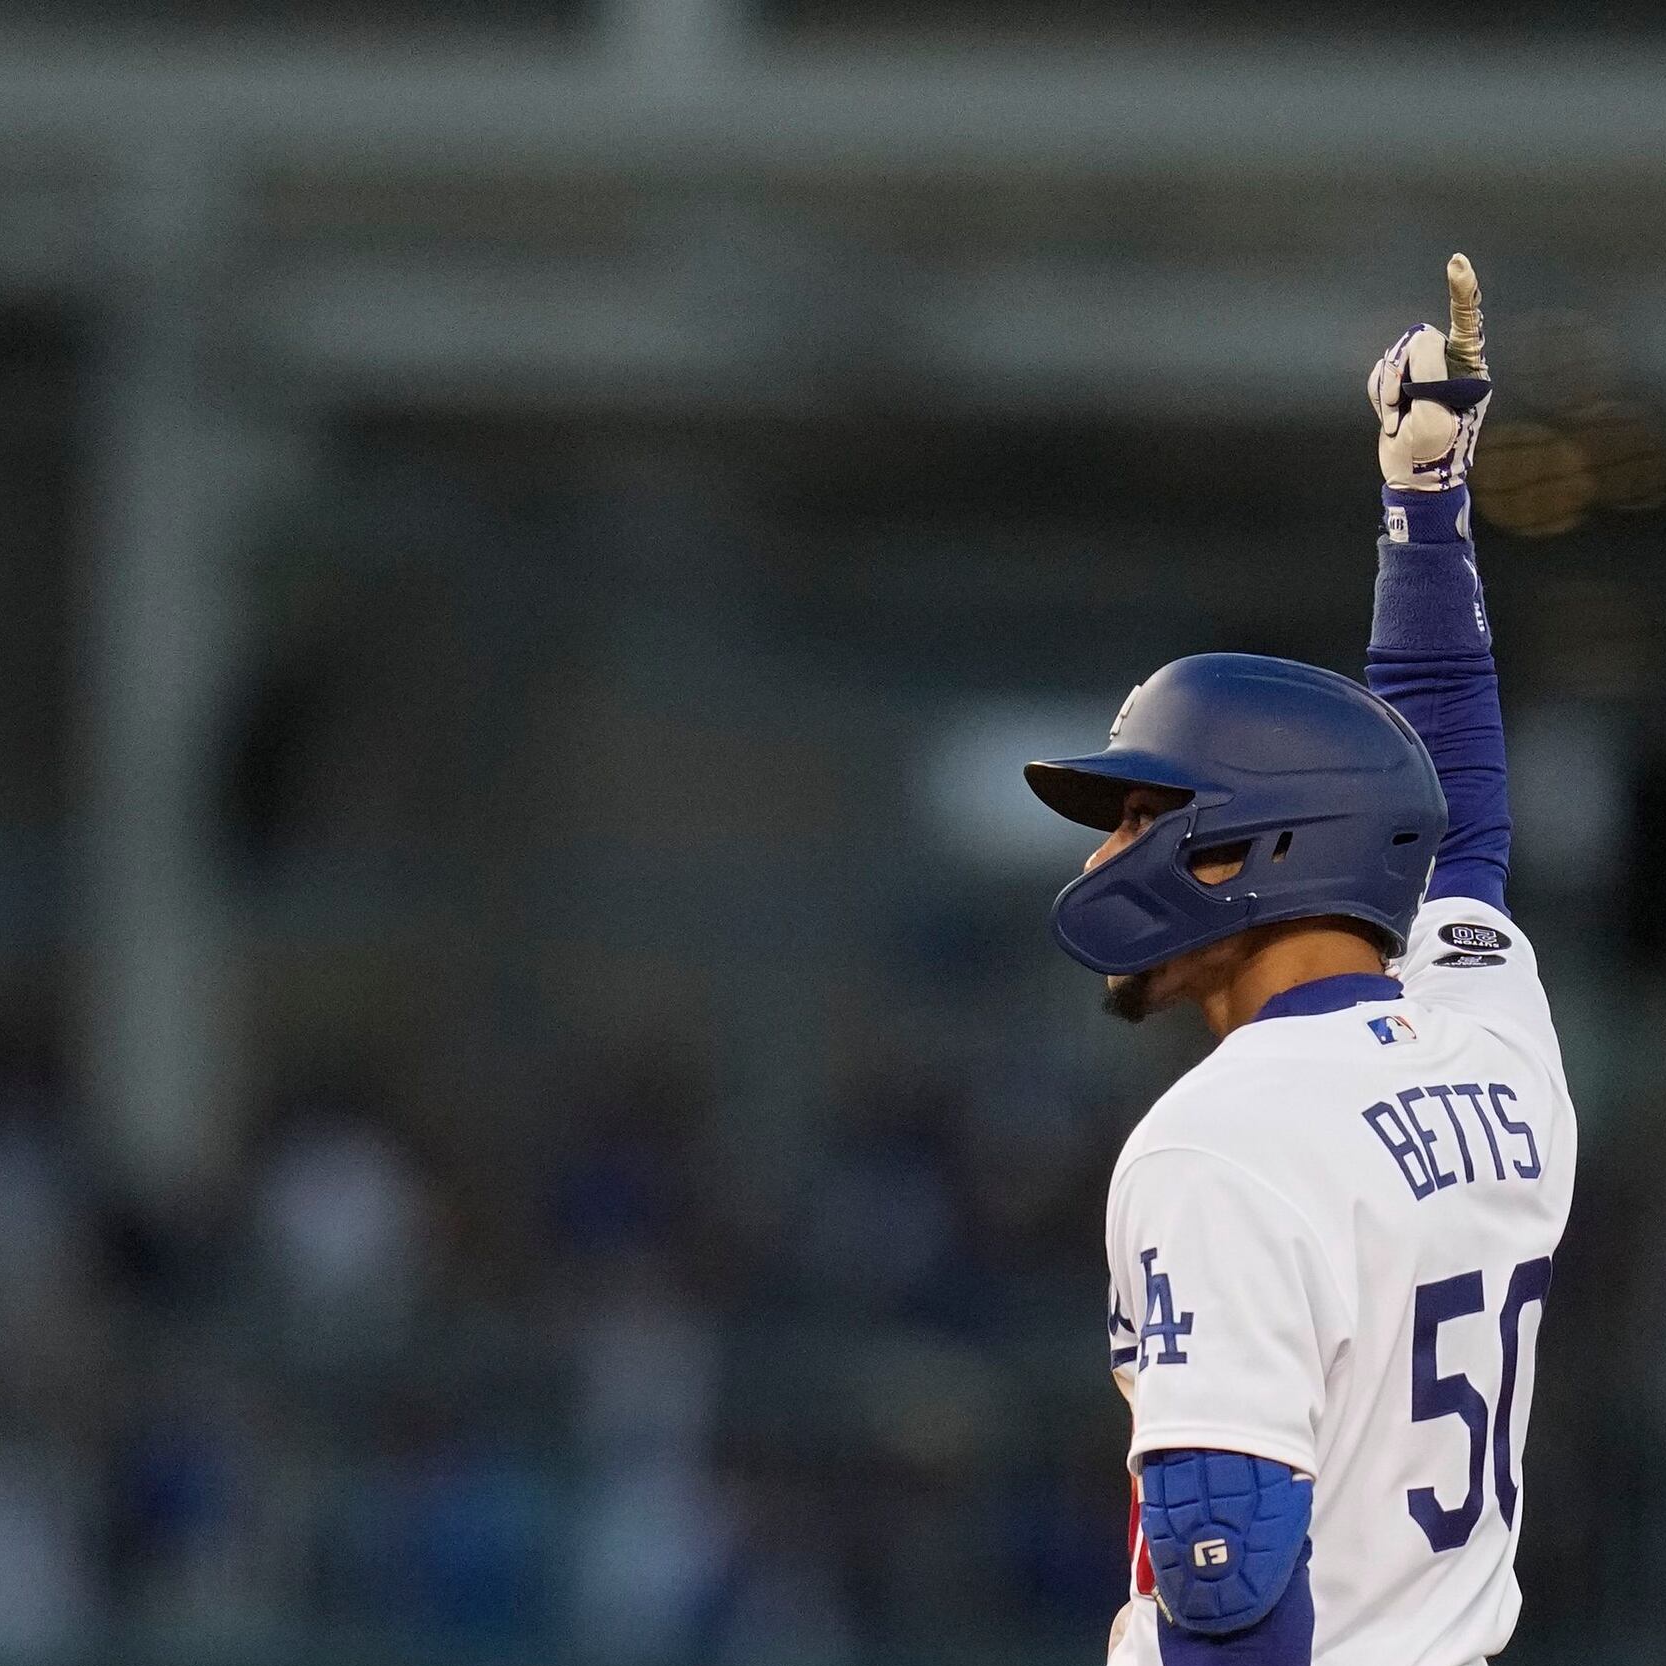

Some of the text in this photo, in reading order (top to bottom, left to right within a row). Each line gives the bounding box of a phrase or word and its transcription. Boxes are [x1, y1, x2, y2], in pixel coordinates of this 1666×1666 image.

[1452, 926, 1497, 943] 20
[1453, 939, 1500, 948] SUTTON
[1361, 1082, 1541, 1201] BETTS
[1138, 1246, 1195, 1374] LA
